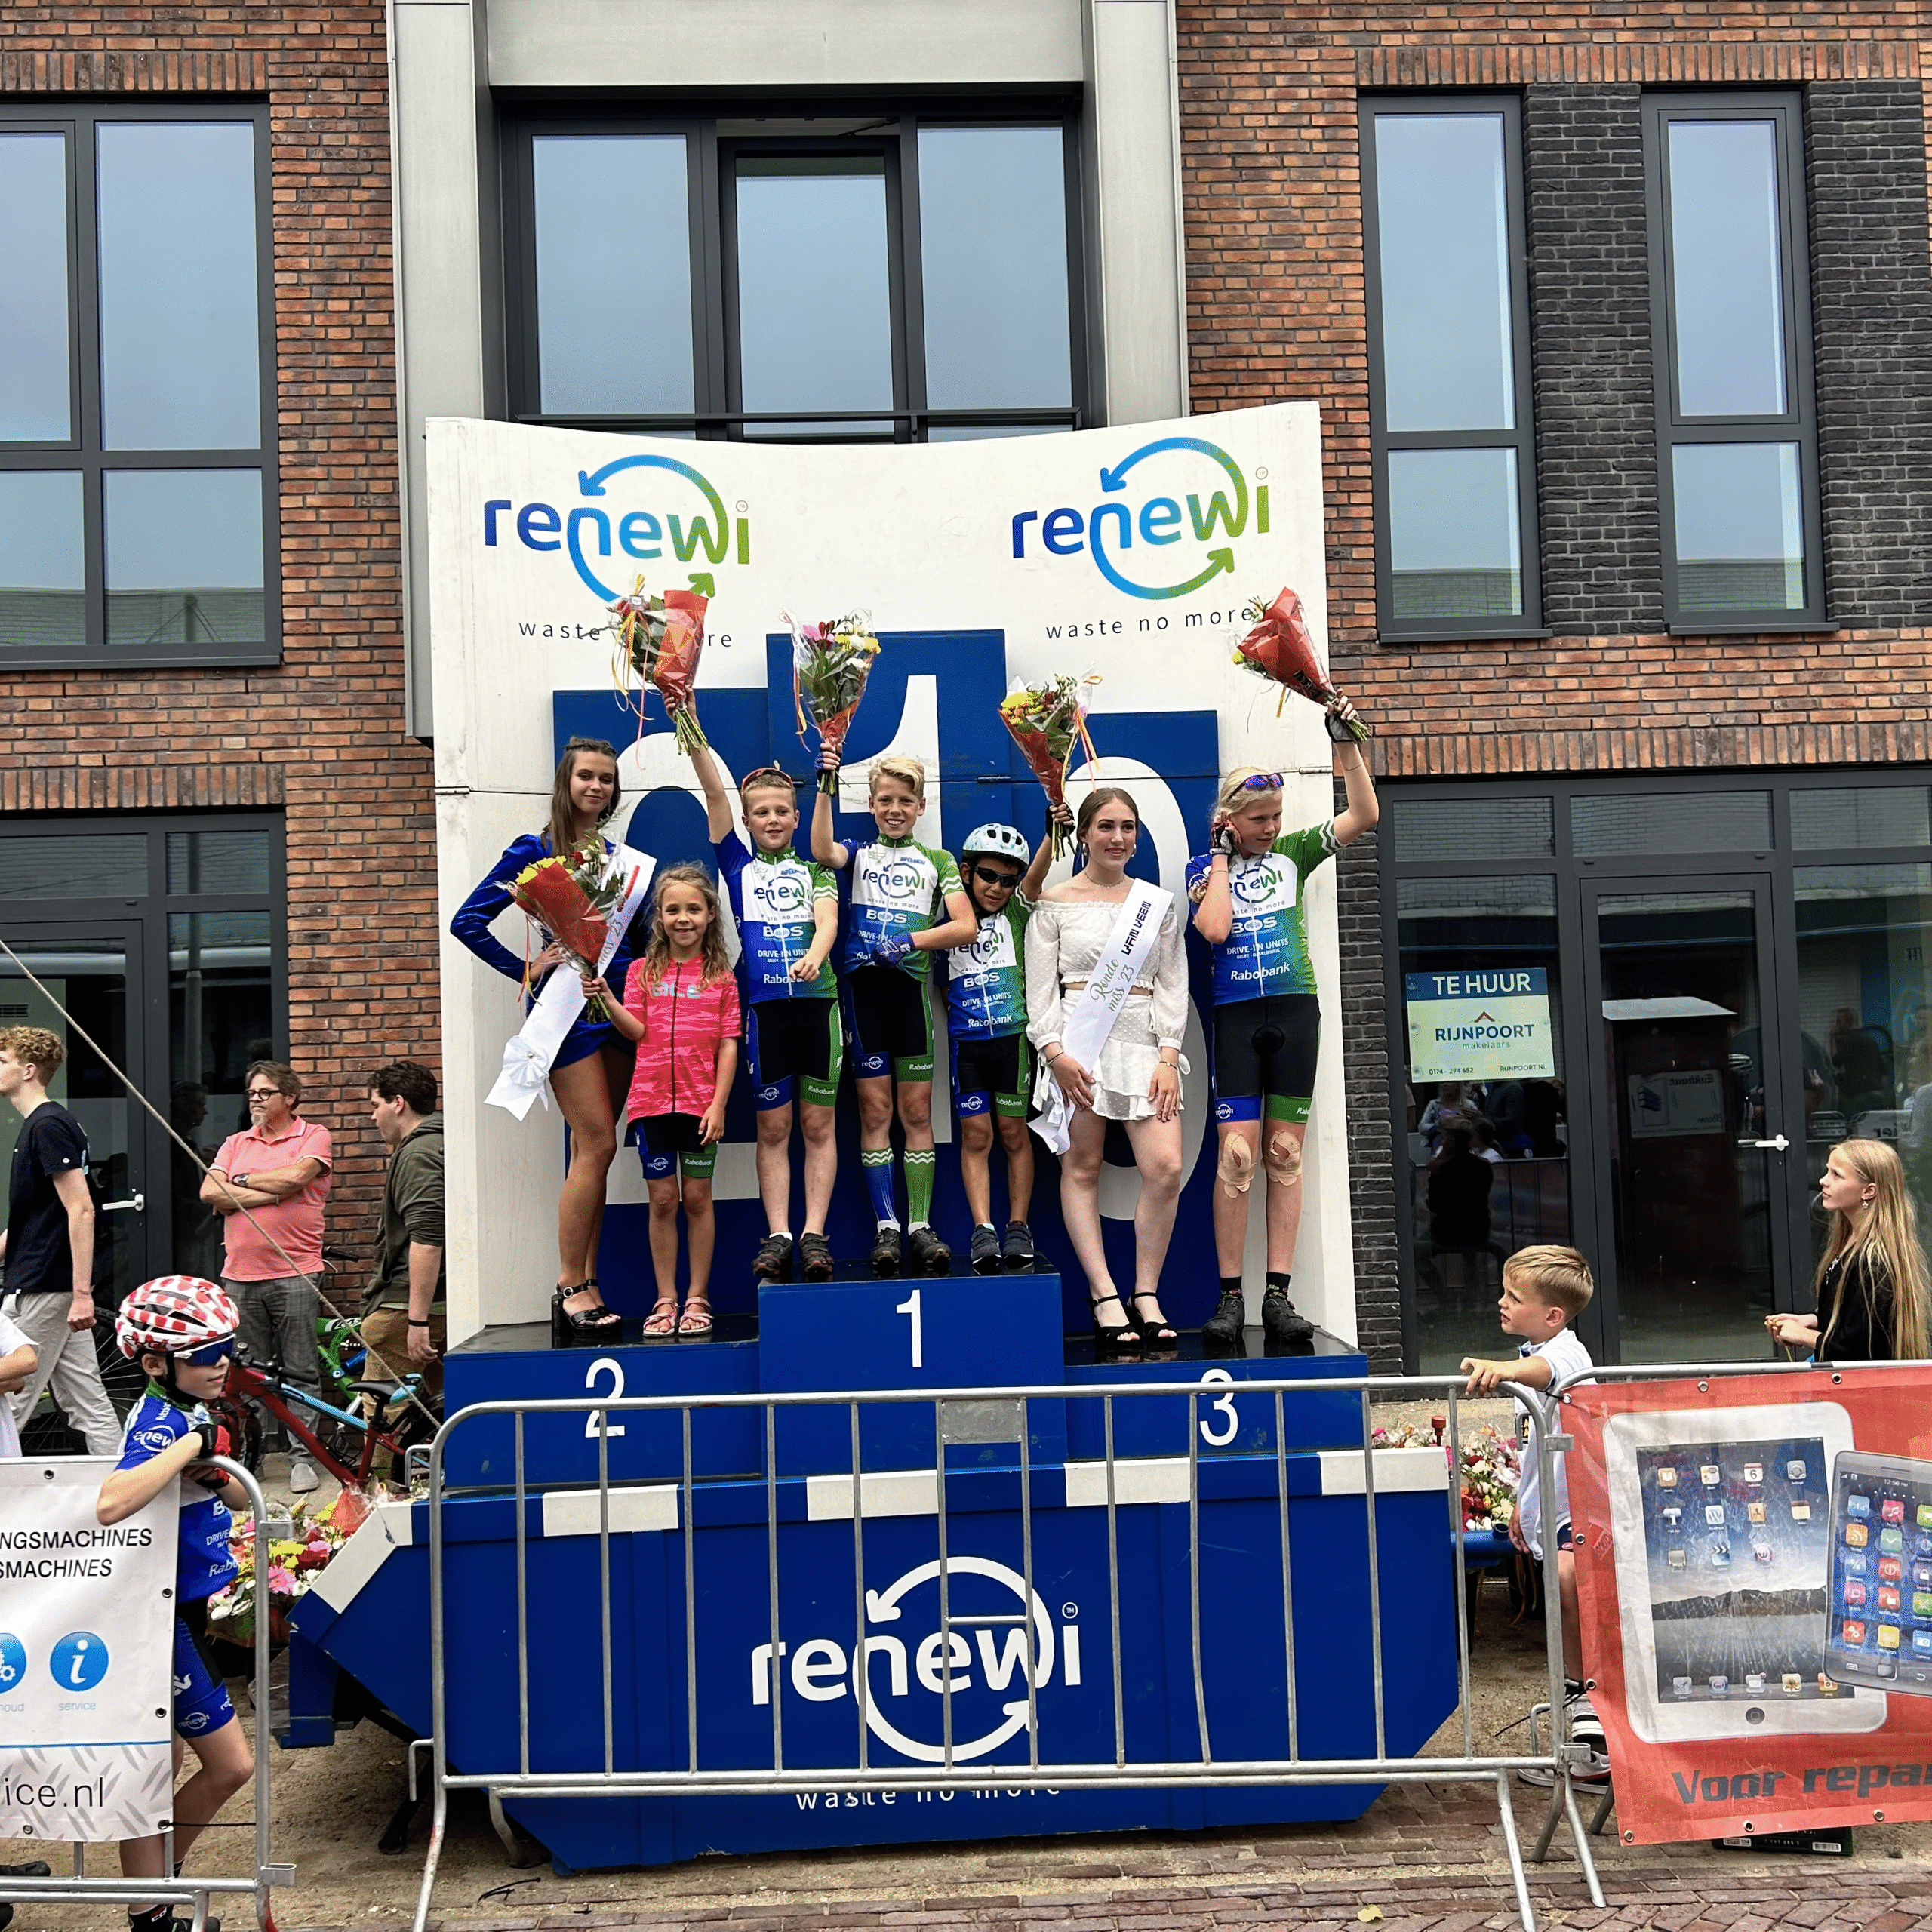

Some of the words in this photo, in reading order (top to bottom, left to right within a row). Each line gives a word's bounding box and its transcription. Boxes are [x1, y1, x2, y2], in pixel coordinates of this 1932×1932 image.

[1012, 469, 1269, 558] renewi
[484, 500, 749, 565] renewi
[1046, 619, 1123, 639] waste
[1139, 615, 1169, 632] no
[1186, 608, 1252, 628] more
[519, 622, 601, 641] waste
[709, 632, 732, 648] re
[863, 869, 925, 889] renewi
[1266, 900, 1285, 910] more
[866, 909, 907, 923] BOS
[1231, 916, 1278, 934] BOS
[763, 926, 804, 938] BOS
[1266, 938, 1289, 949] UNITS
[964, 972, 1000, 988] BOS
[1089, 958, 1119, 1001] Ronde
[1231, 962, 1290, 980] Rabobank
[1432, 976, 1460, 995] TE
[1466, 973, 1531, 994] HUUR
[1108, 987, 1125, 1012] miss
[968, 1013, 1012, 1028] Rabobank
[1435, 1023, 1534, 1041] RIJNPOORT
[1462, 1041, 1511, 1050] makelaars
[896, 1289, 922, 1367] 1
[585, 1358, 625, 1439] 2
[1198, 1369, 1239, 1446] 3
[0, 1528, 152, 1549] NGSMACHINES
[752, 1604, 1081, 1706] renewi
[58, 1702, 97, 1711] service
[5, 1777, 103, 1807] ice.nl
[1671, 1769, 1785, 1804] Voor
